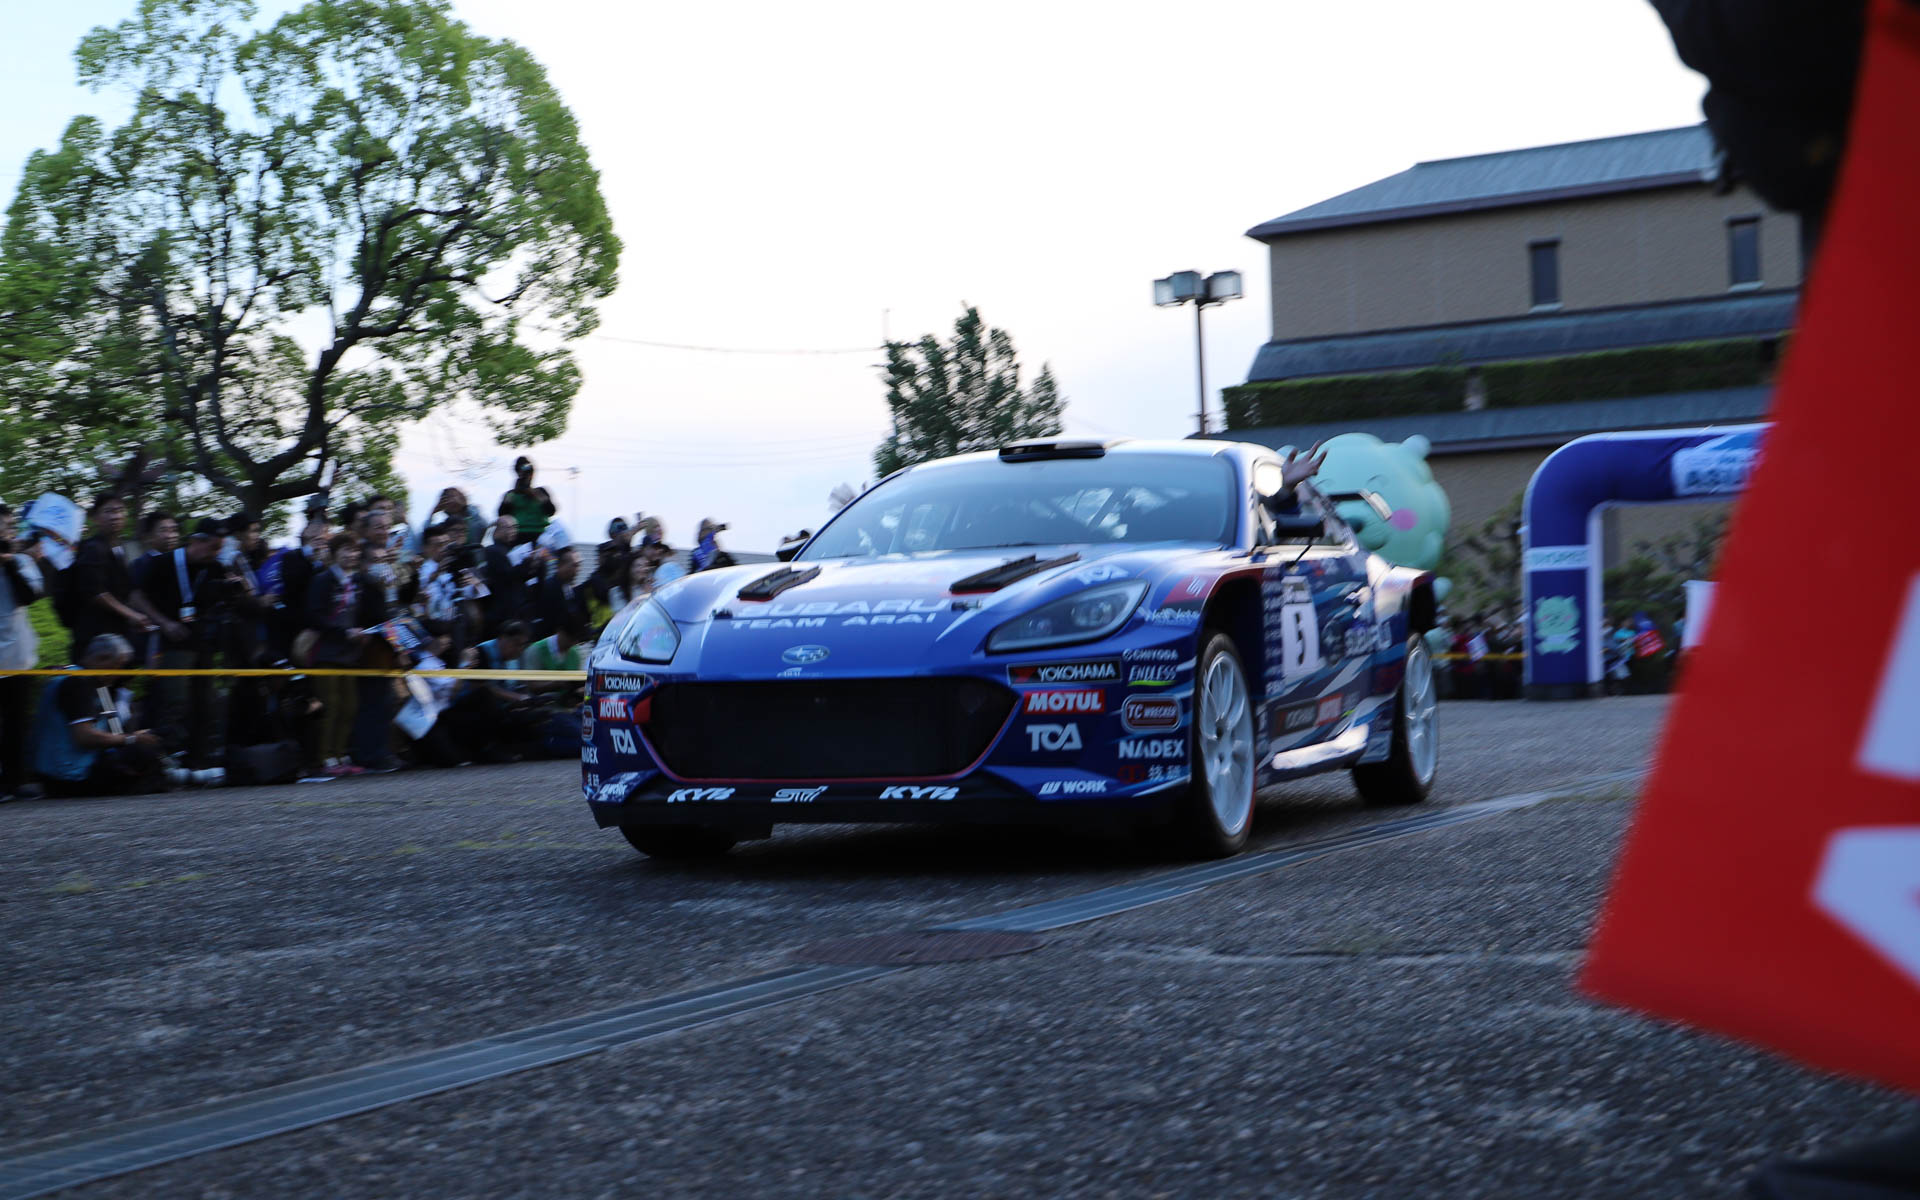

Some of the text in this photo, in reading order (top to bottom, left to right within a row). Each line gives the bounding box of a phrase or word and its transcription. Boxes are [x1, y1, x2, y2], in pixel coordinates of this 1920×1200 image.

[738, 600, 950, 617] SUBARU
[730, 613, 937, 629] TEAM ARAI
[1037, 664, 1116, 682] YOKOHAMA
[1129, 665, 1177, 681] ENDLESS
[604, 676, 641, 691] YOKOHAMA
[600, 701, 627, 719] MOTUL
[1027, 692, 1103, 712] MOTUL
[1128, 704, 1143, 719] TC
[1118, 739, 1184, 759] NADEX
[879, 785, 960, 800] KYB
[1063, 780, 1107, 793] WORK
[667, 787, 736, 803] KYB
